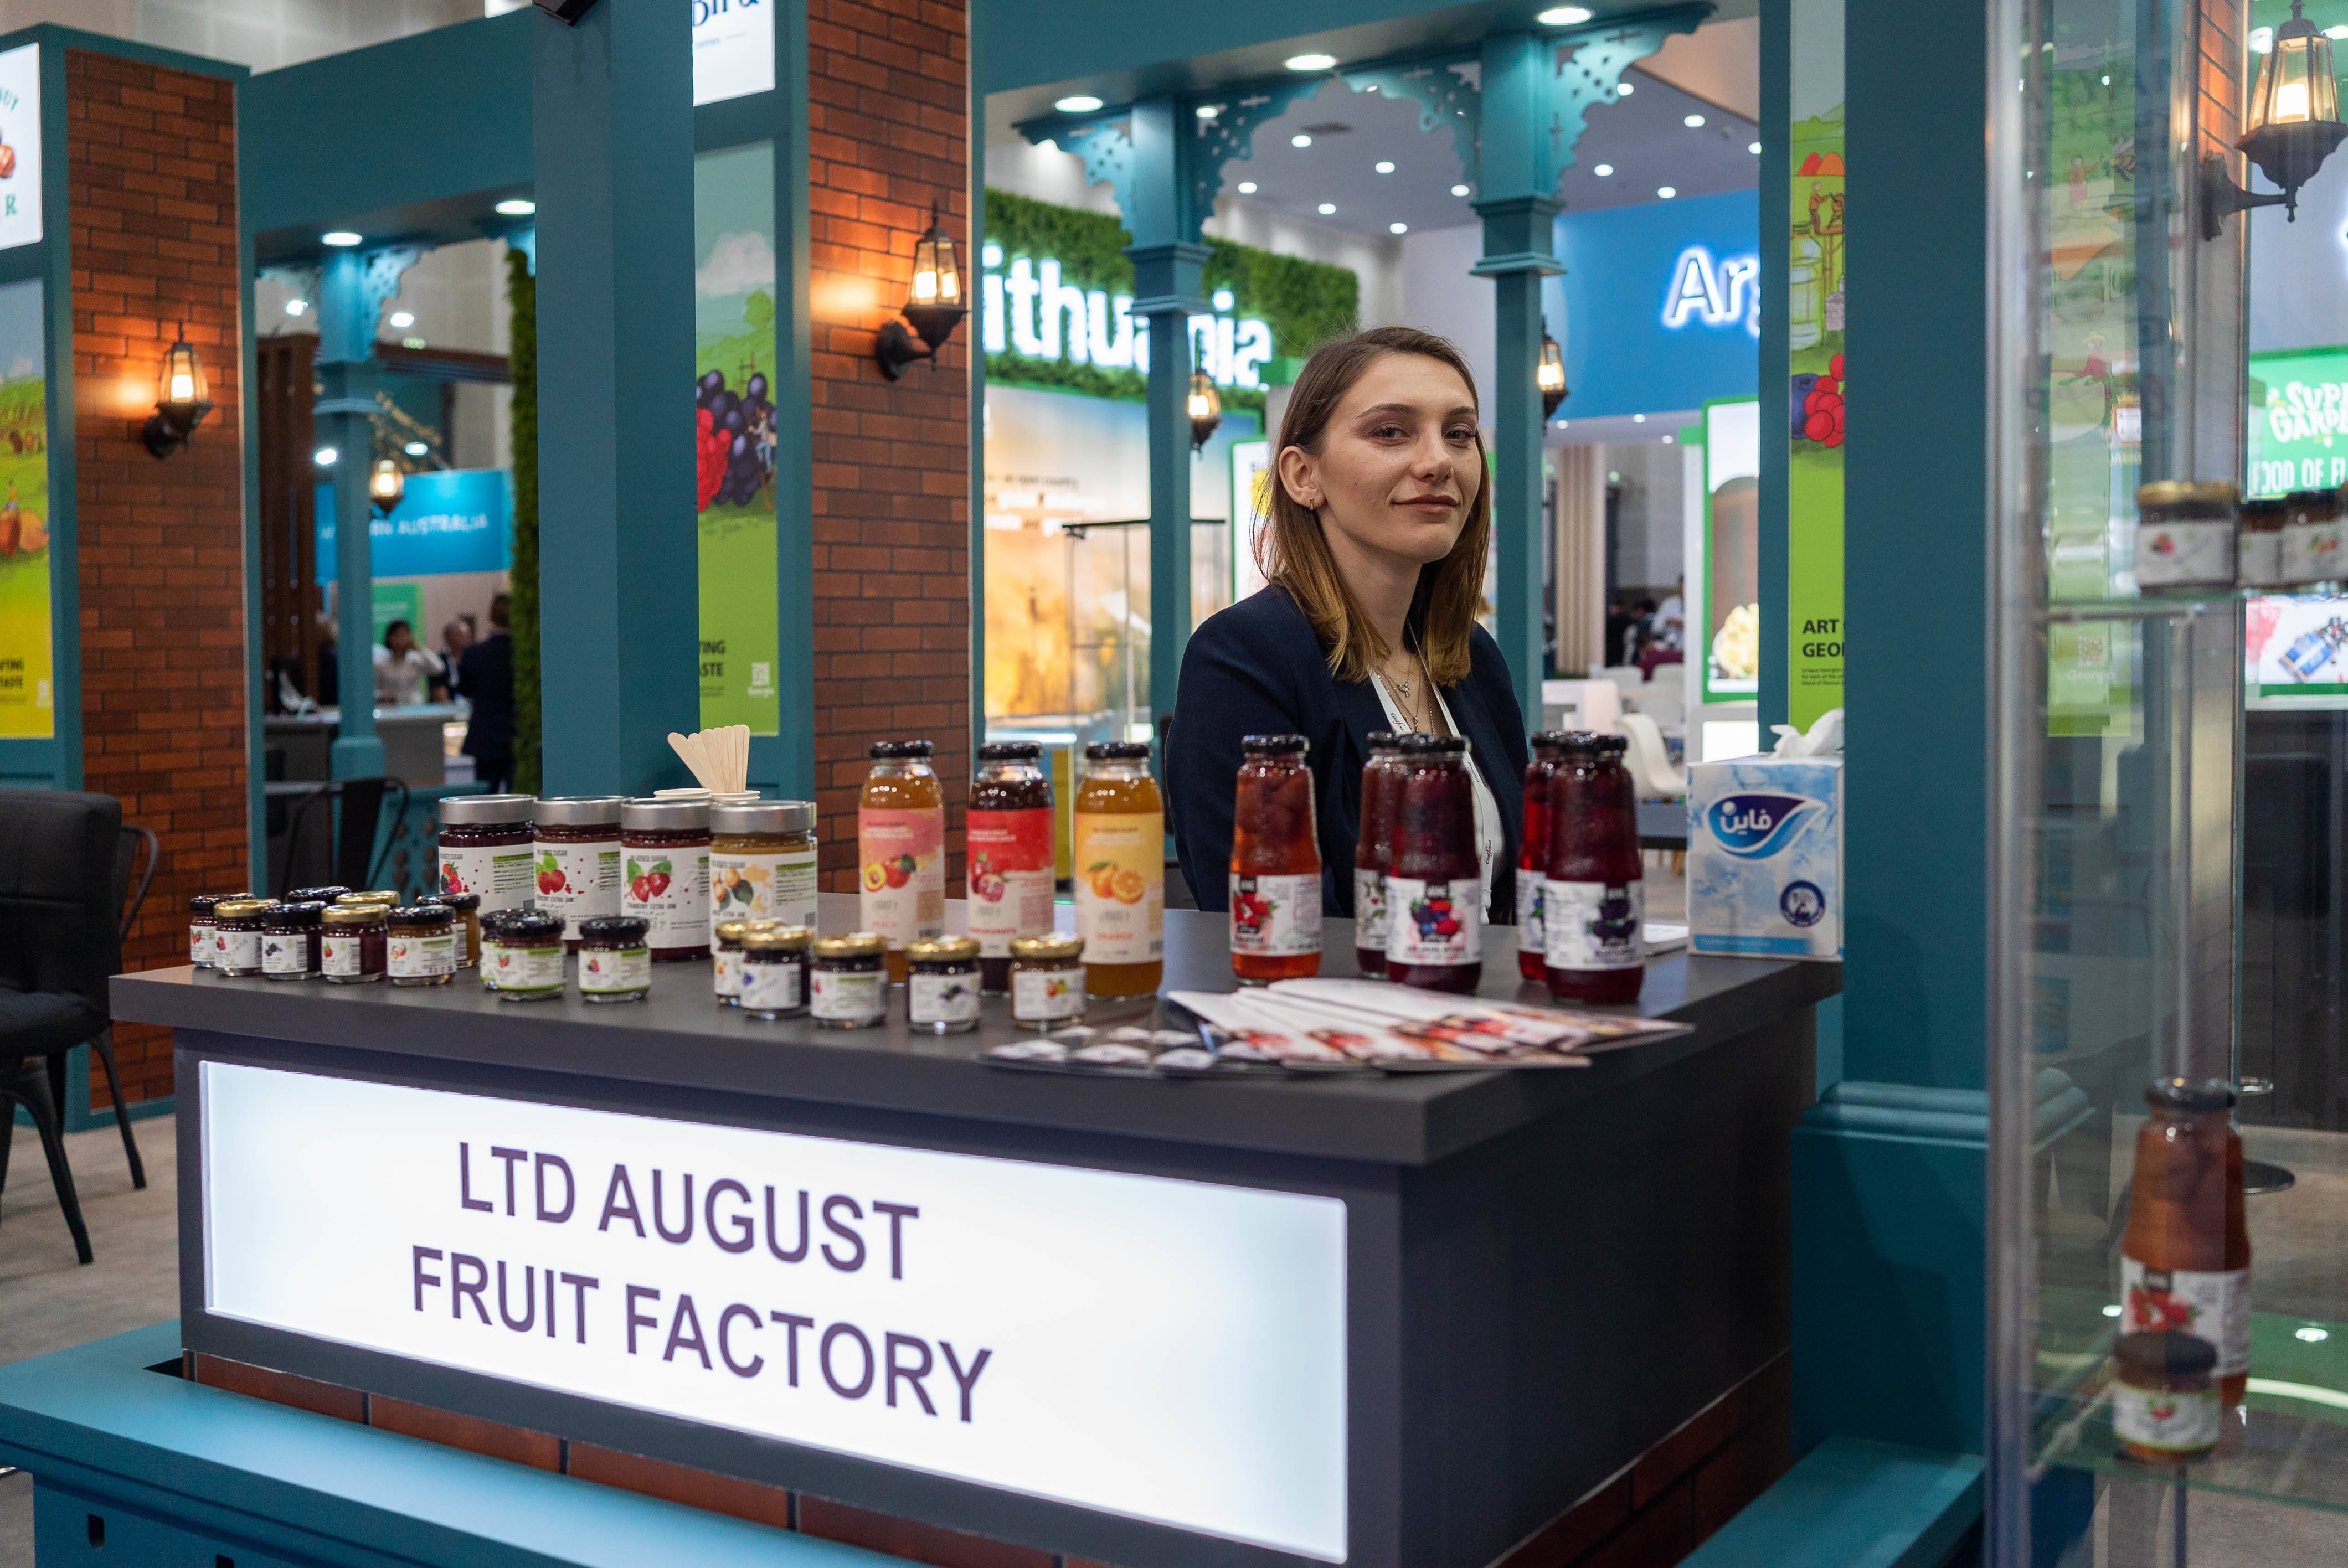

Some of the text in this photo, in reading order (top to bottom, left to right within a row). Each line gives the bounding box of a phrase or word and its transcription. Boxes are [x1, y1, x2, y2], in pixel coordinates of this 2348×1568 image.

[2301, 458, 2324, 488] OF
[1803, 619, 1839, 634] ART
[1720, 801, 1773, 834] فاين
[460, 1142, 919, 1281] LTD AUGUST
[413, 1245, 992, 1423] FRUIT FACTORY
